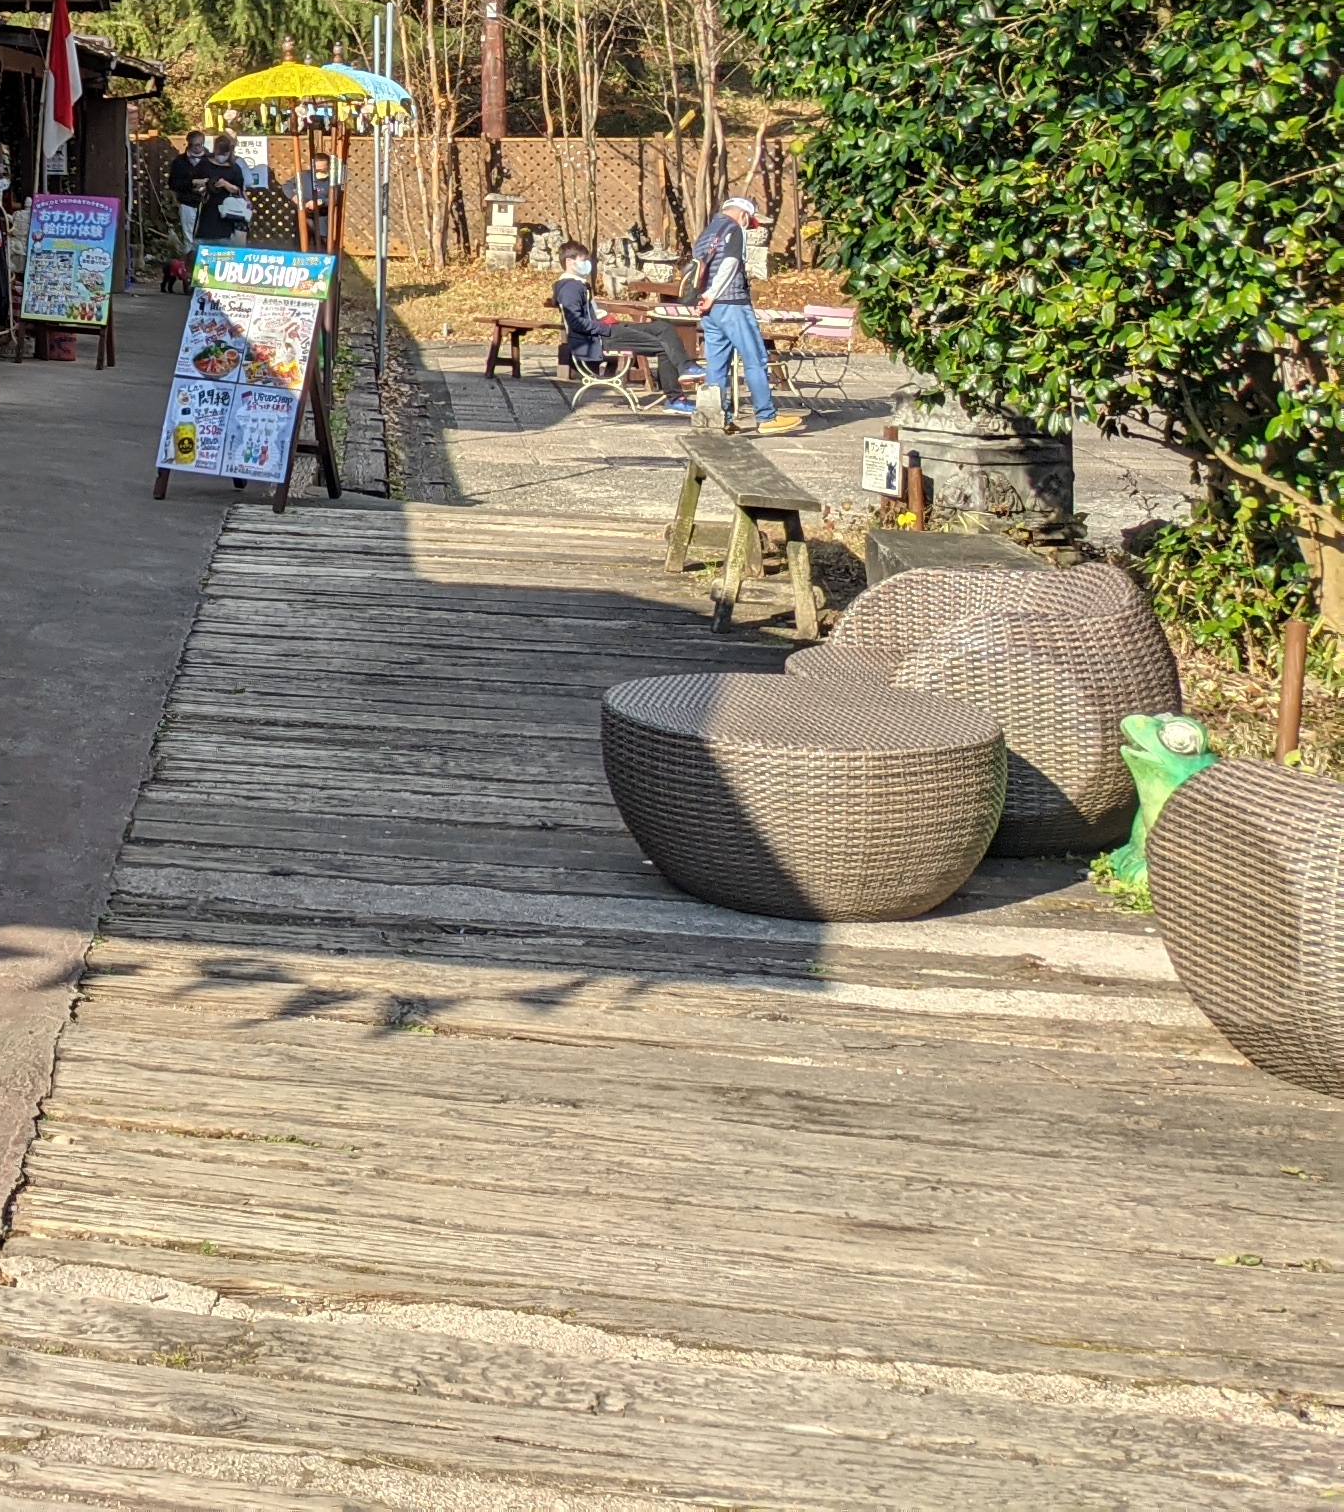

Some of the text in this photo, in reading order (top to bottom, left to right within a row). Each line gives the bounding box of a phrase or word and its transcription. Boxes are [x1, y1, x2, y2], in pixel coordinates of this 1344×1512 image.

[39, 209, 111, 225] おすわり人形
[42, 223, 103, 238] 絵付け体験
